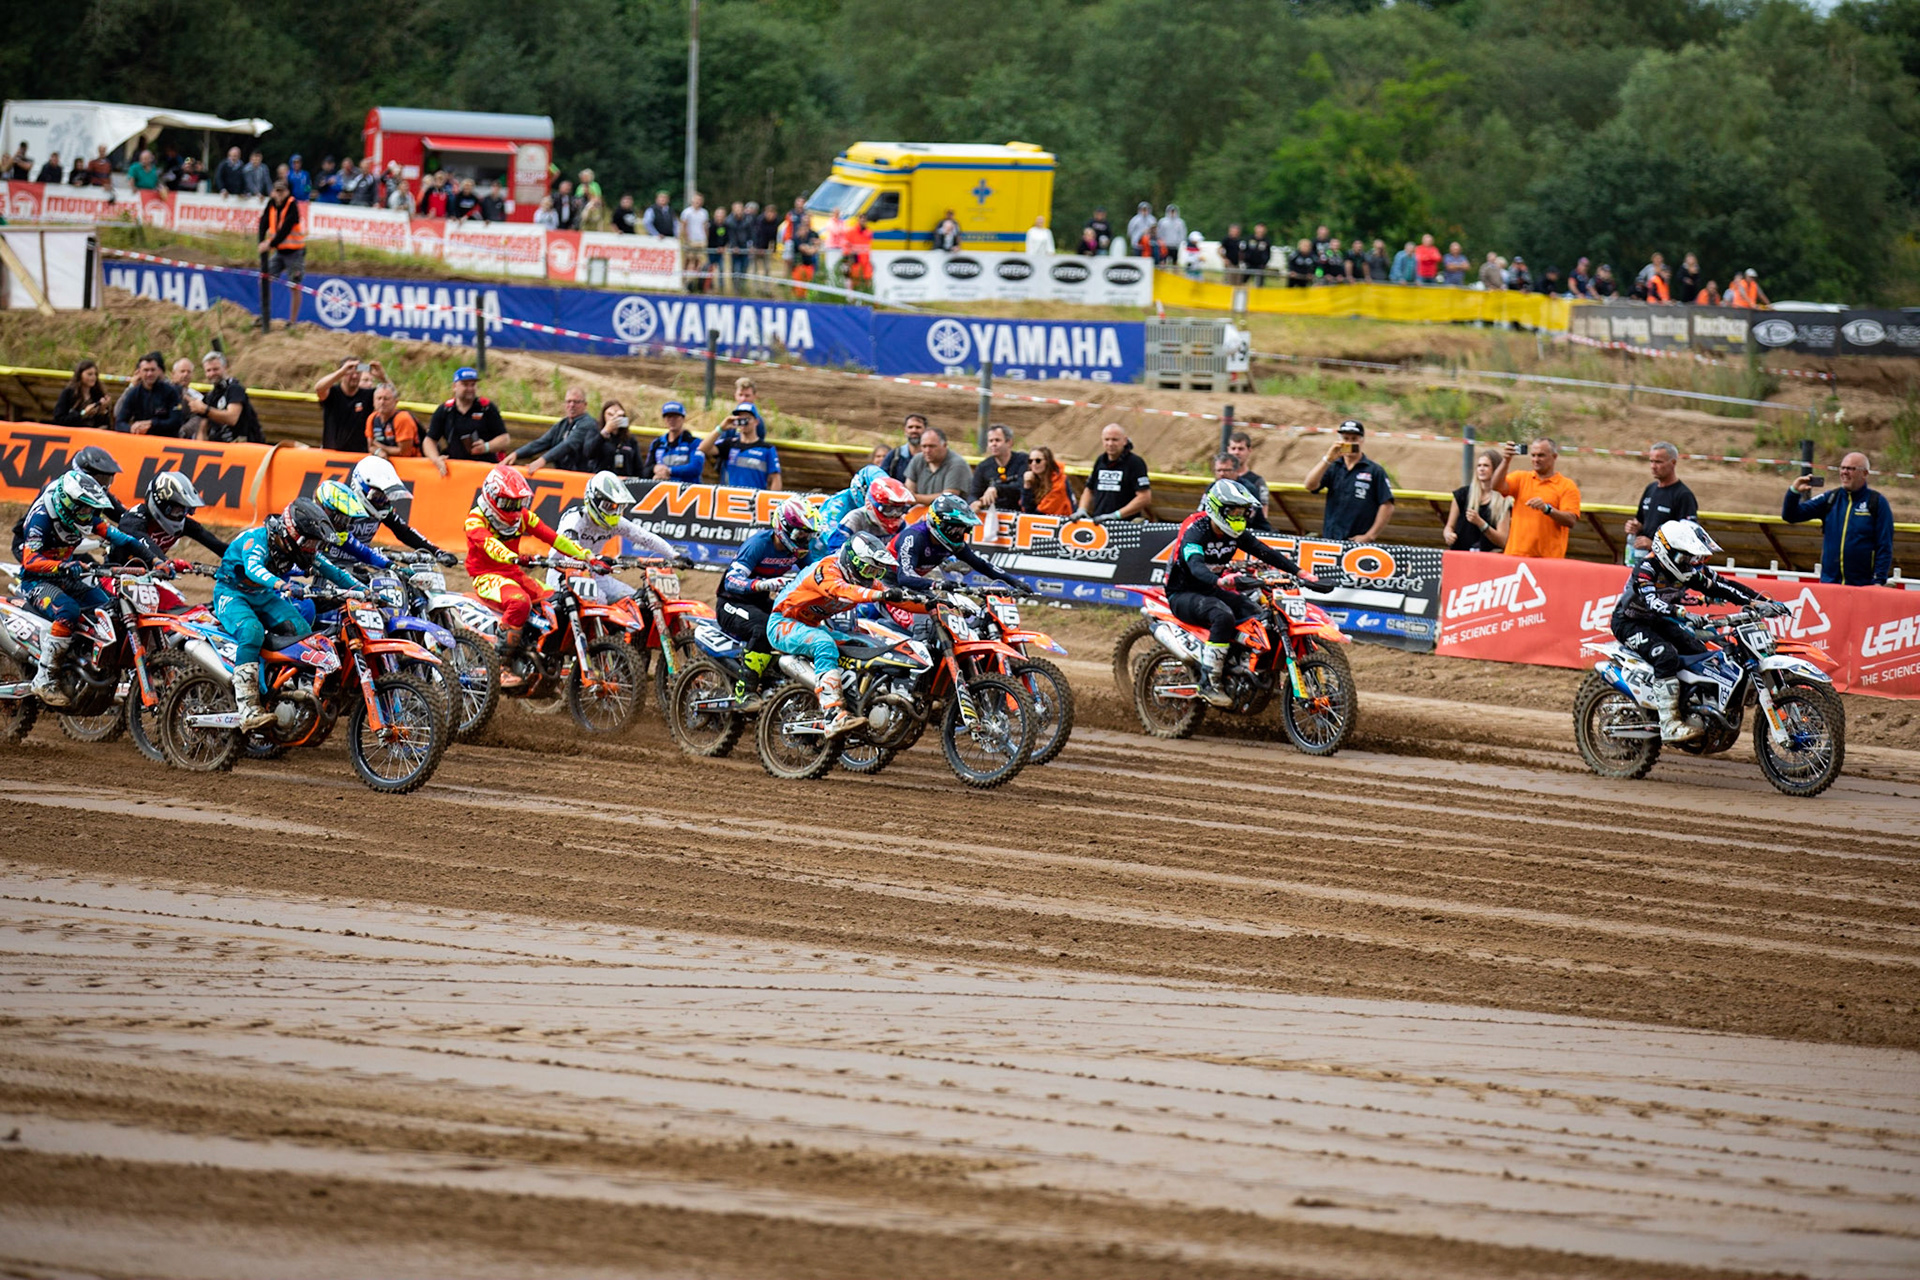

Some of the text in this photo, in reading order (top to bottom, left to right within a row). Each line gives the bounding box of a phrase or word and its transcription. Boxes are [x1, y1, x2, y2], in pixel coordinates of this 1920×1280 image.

[358, 282, 503, 332] YAMAHA
[657, 300, 815, 349] YAMAHA
[971, 323, 1122, 367] YAMAHA
[134, 446, 246, 508] KTM
[690, 522, 733, 541] Parts
[1057, 543, 1120, 561] Sport
[128, 584, 160, 605] 766
[655, 578, 680, 595] 403
[994, 604, 1021, 625] 15
[1281, 599, 1306, 617] 755
[947, 613, 969, 636] 60
[1442, 612, 1546, 646] THE SCIENCE OF THRILL
[704, 627, 732, 648] 121
[1174, 629, 1199, 651] 755
[1748, 629, 1774, 650] 104
[1861, 672, 1879, 687] THE
